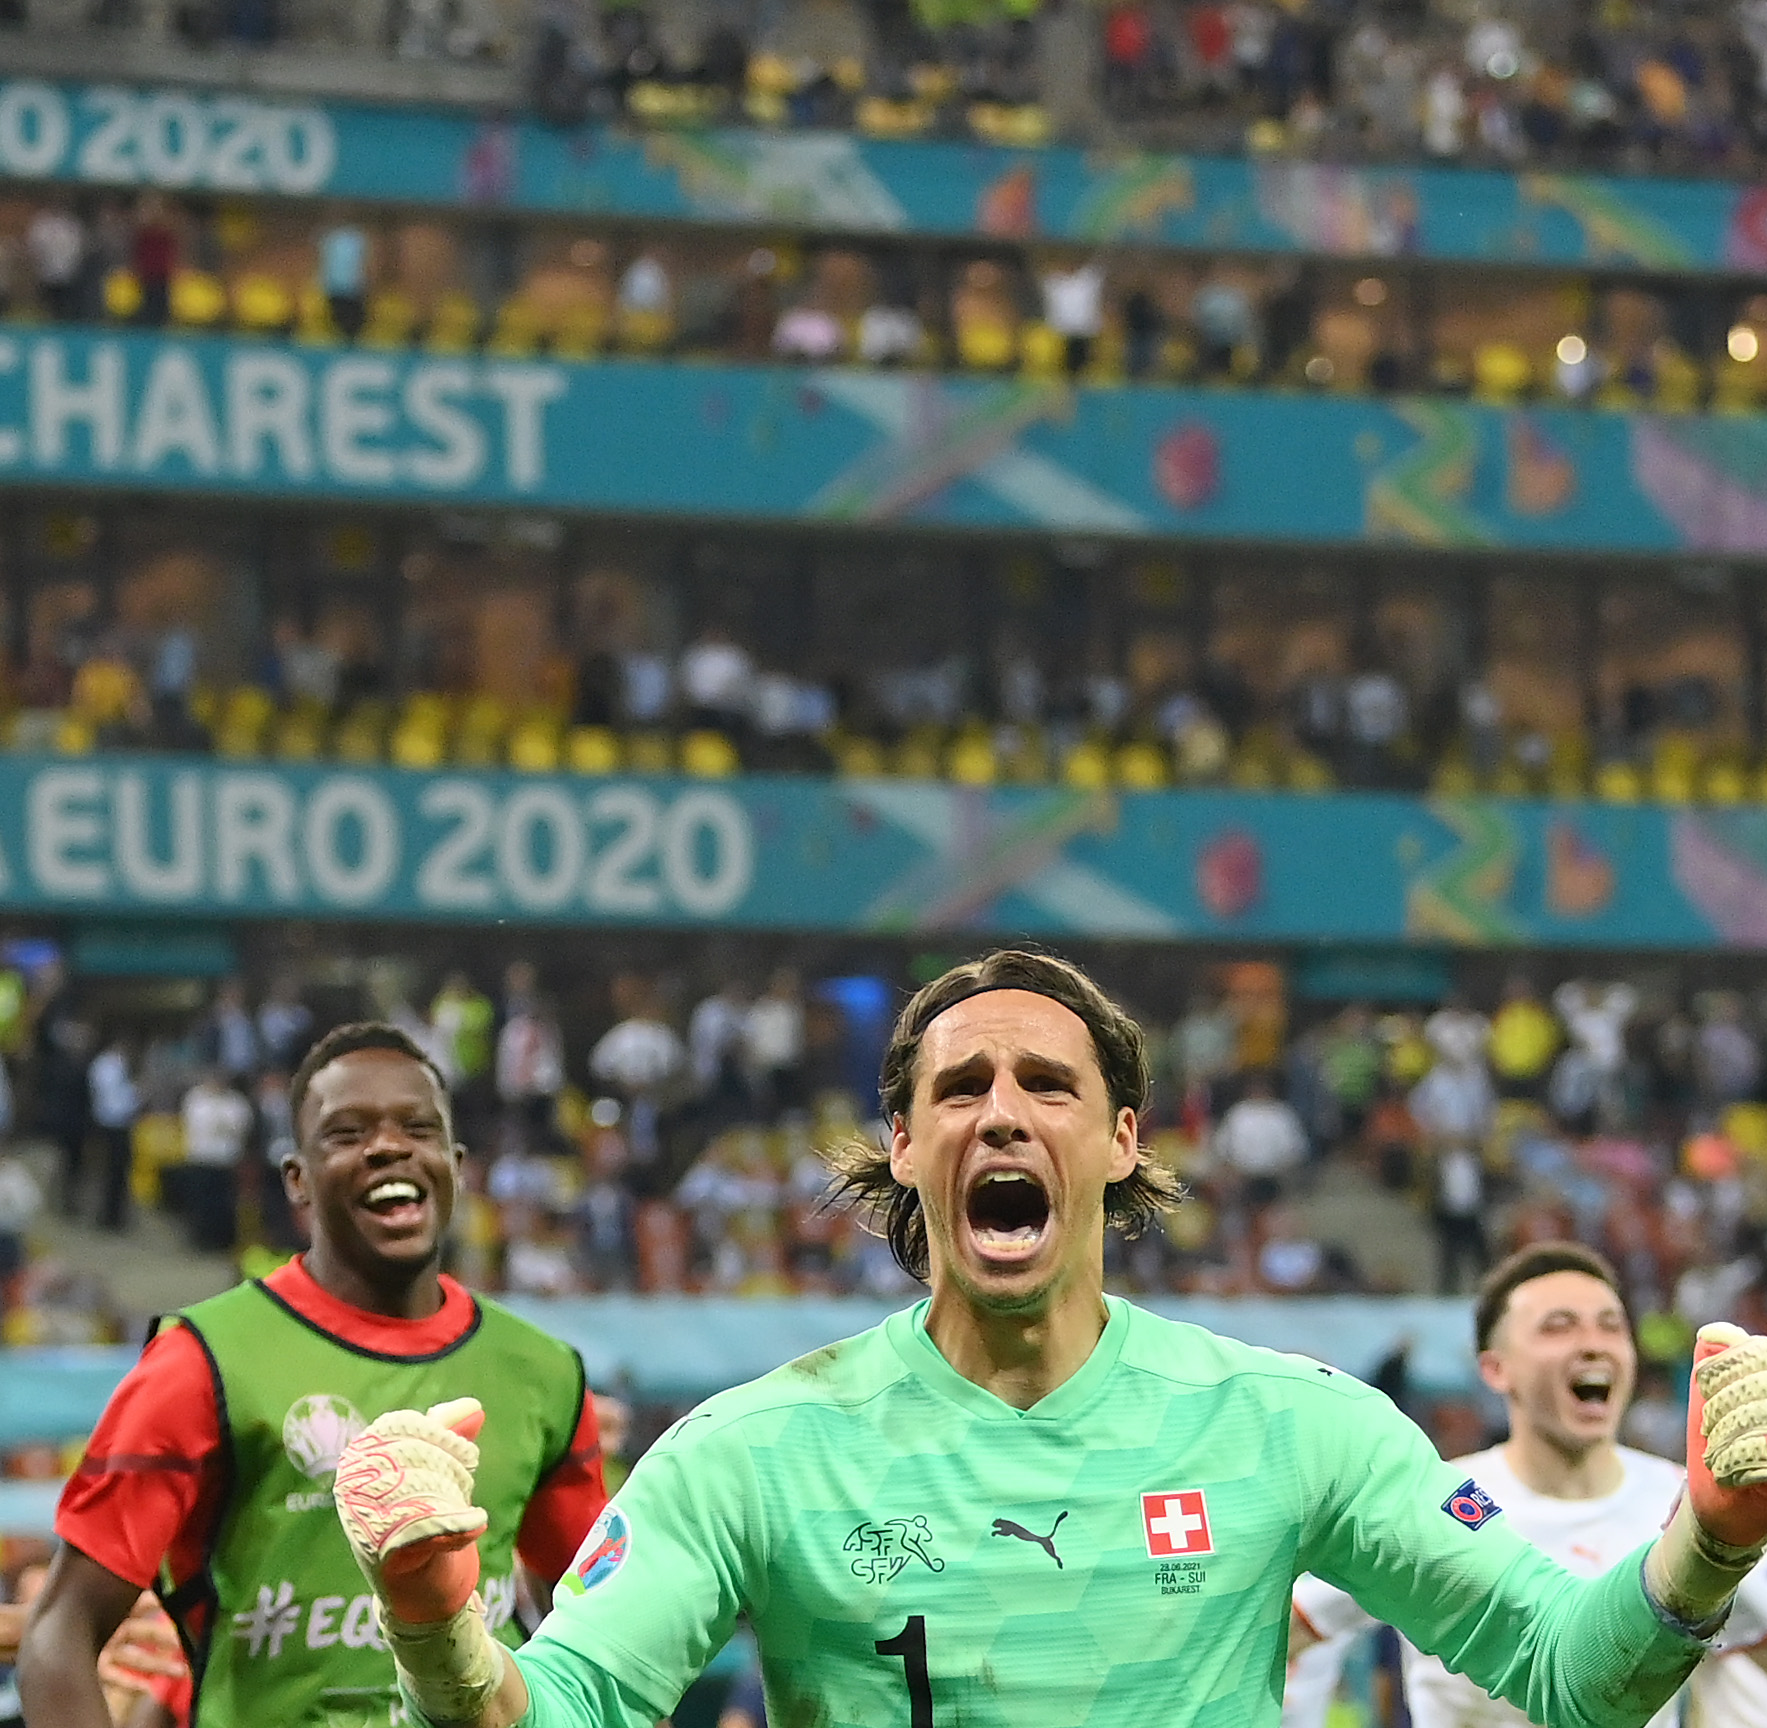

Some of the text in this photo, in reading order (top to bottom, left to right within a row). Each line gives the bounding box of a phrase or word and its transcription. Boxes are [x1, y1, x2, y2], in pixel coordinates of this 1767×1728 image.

[79, 86, 337, 194] 2020
[31, 768, 398, 903] EURO
[416, 784, 755, 916] 2020
[1154, 1573, 1177, 1585] FRA
[1188, 1571, 1206, 1583] SUI
[1161, 1585, 1200, 1595] BUKAREST
